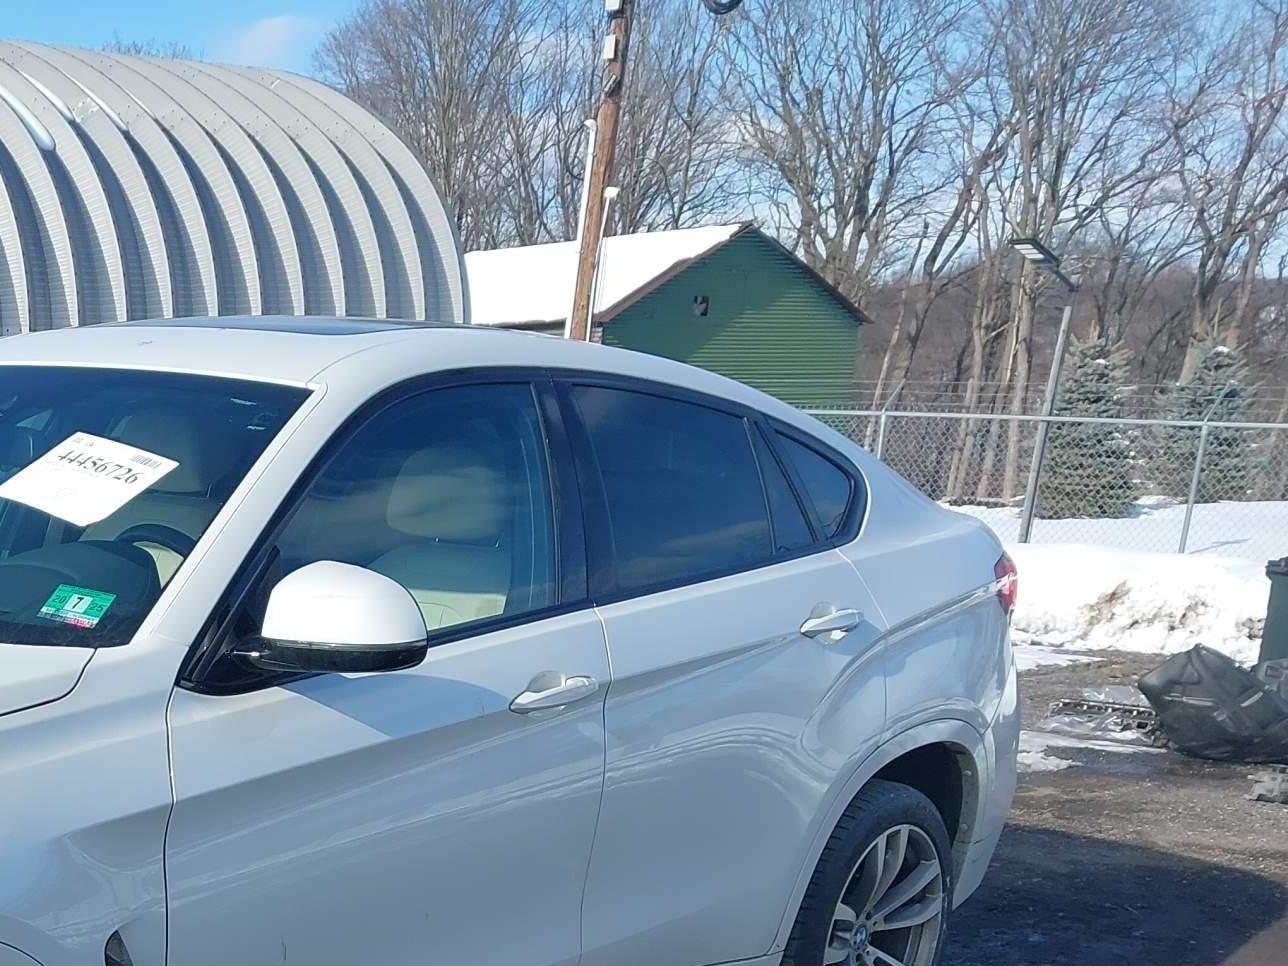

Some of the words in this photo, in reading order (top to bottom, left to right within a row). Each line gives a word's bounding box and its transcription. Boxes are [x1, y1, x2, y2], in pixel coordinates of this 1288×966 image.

[58, 449, 144, 485] 44456726
[73, 596, 84, 609] 7
[89, 602, 104, 612] 25
